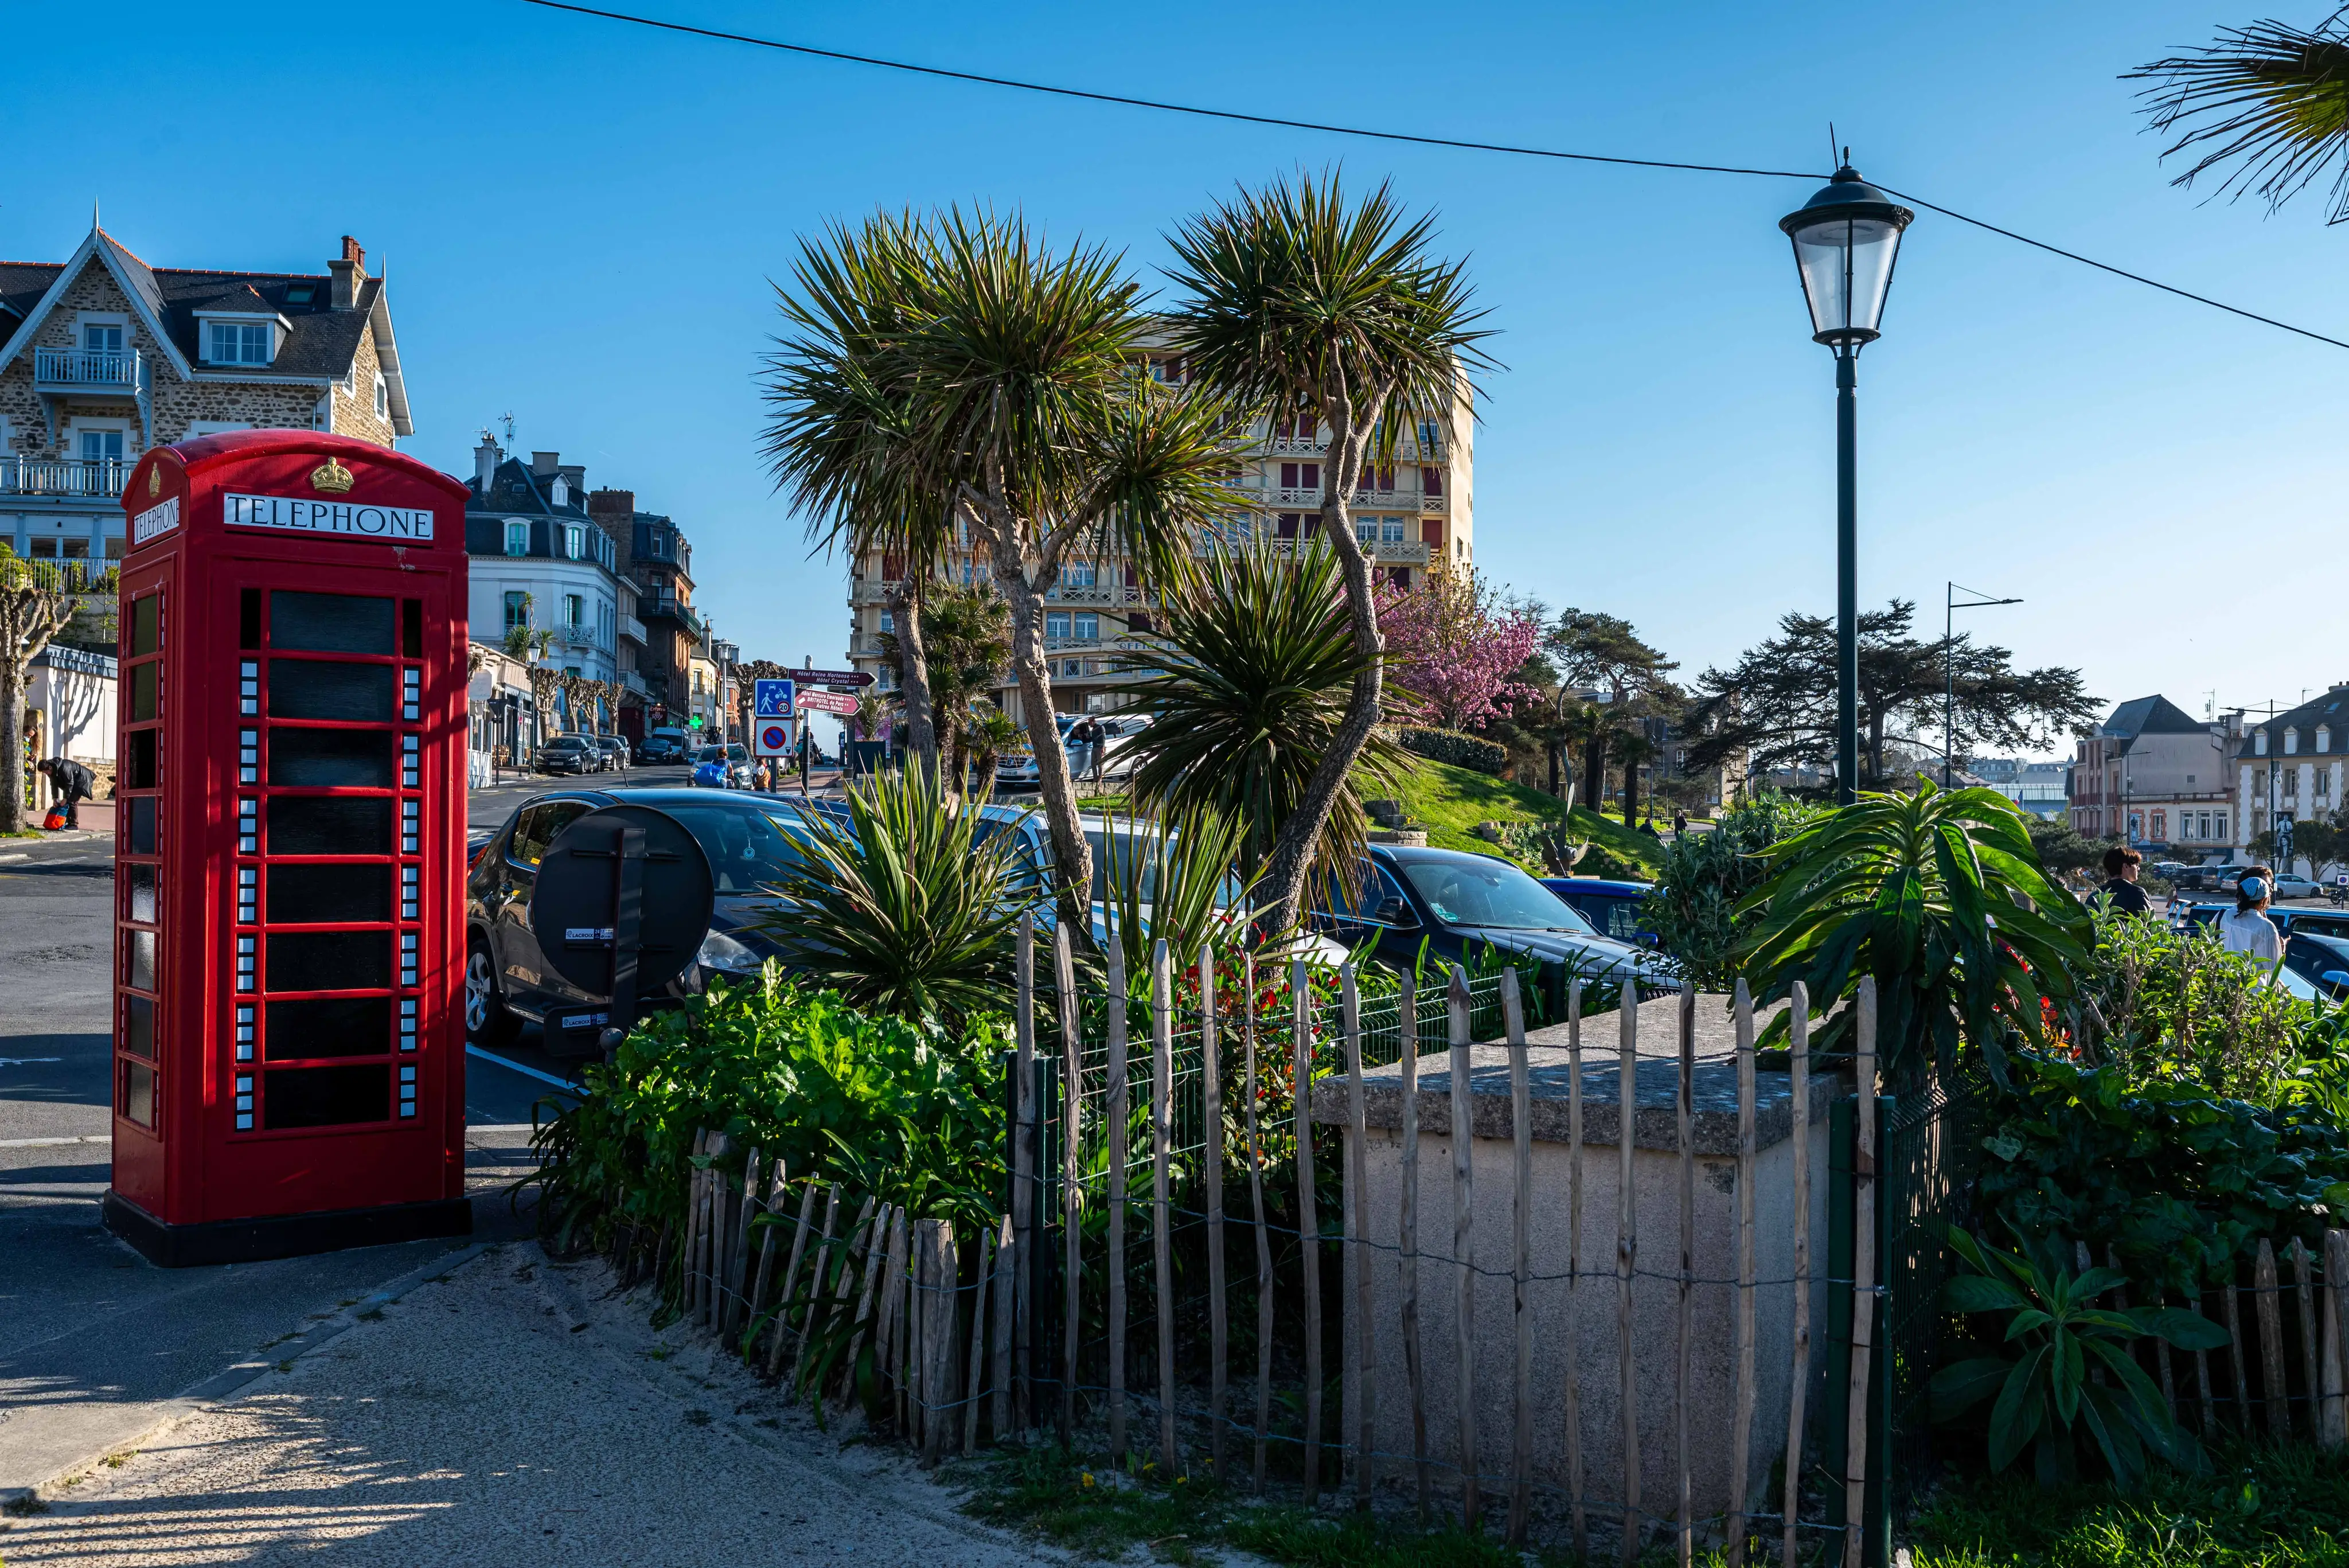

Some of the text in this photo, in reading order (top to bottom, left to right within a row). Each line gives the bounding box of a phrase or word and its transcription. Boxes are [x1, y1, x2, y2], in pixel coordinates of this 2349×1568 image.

[135, 498, 179, 541] TELEPHONE
[228, 496, 431, 537] TELEPHONE
[807, 697, 829, 705] BRITHOTEL
